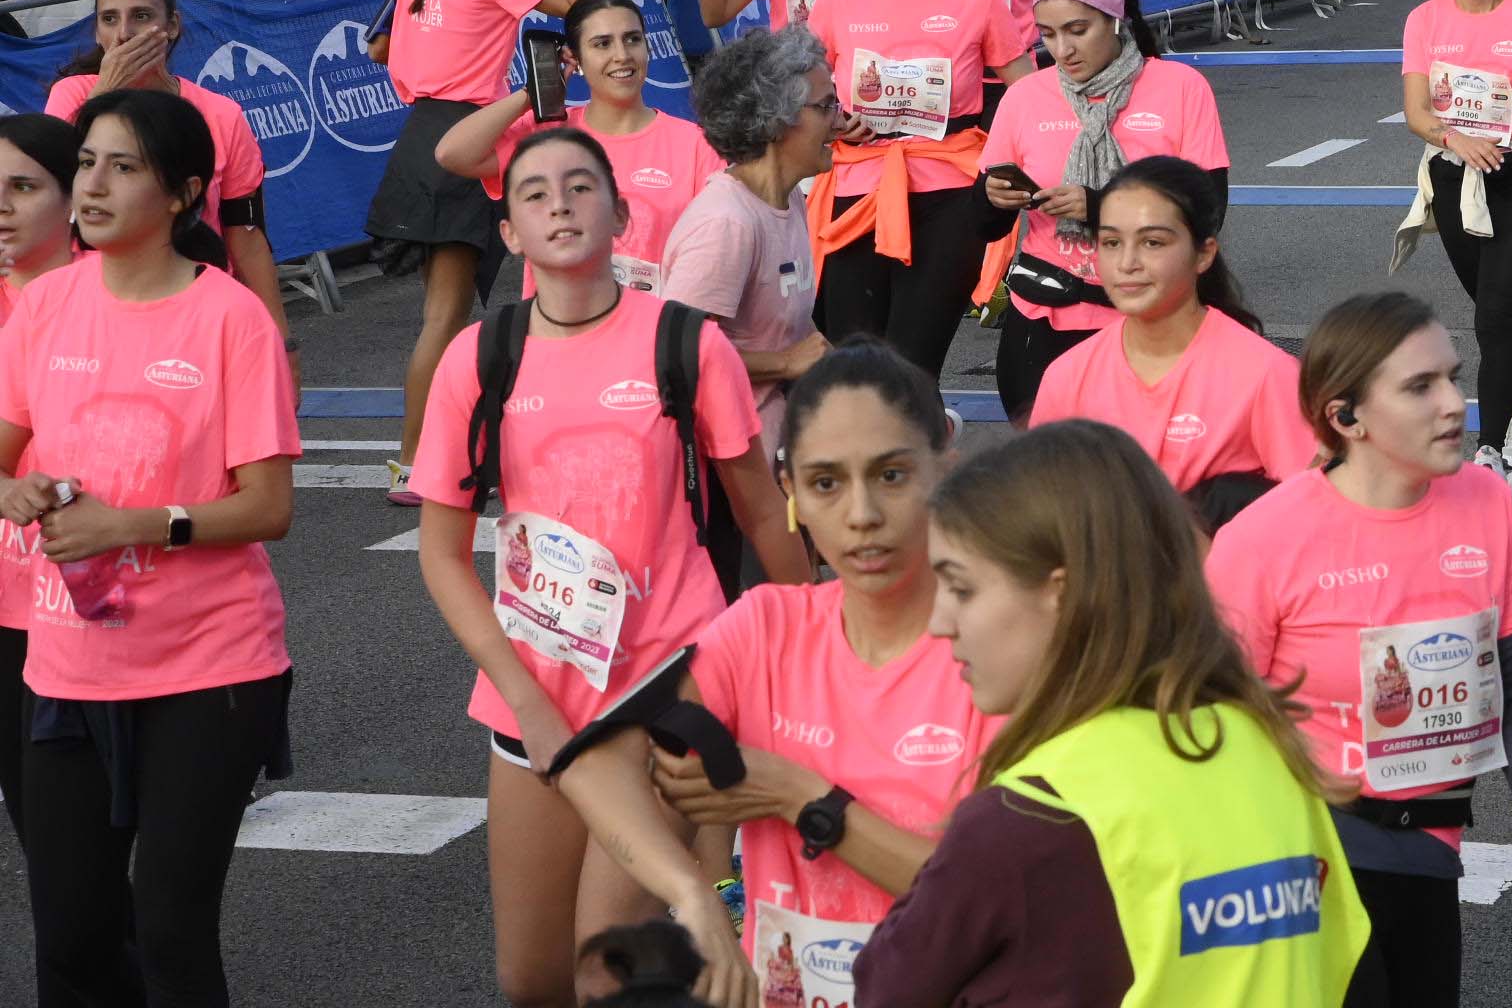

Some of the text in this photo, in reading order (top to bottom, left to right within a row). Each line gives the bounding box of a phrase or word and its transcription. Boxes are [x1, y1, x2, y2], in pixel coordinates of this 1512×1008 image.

[430, 0, 442, 12] LA
[849, 22, 889, 33] OYSHO
[884, 85, 917, 97] 016
[1454, 96, 1483, 111] 016
[1456, 110, 1479, 120] 14906
[149, 367, 200, 384] ASTURIANA
[687, 443, 696, 491] Quechua
[1318, 562, 1390, 590] OYSHO
[533, 572, 576, 607] 016
[1412, 647, 1470, 665] ASTURIANA
[1417, 681, 1468, 708] 016
[1423, 711, 1462, 729] 17930
[1382, 730, 1480, 753] CARRERA DE LA MUJER
[1380, 760, 1427, 779] OYSHO
